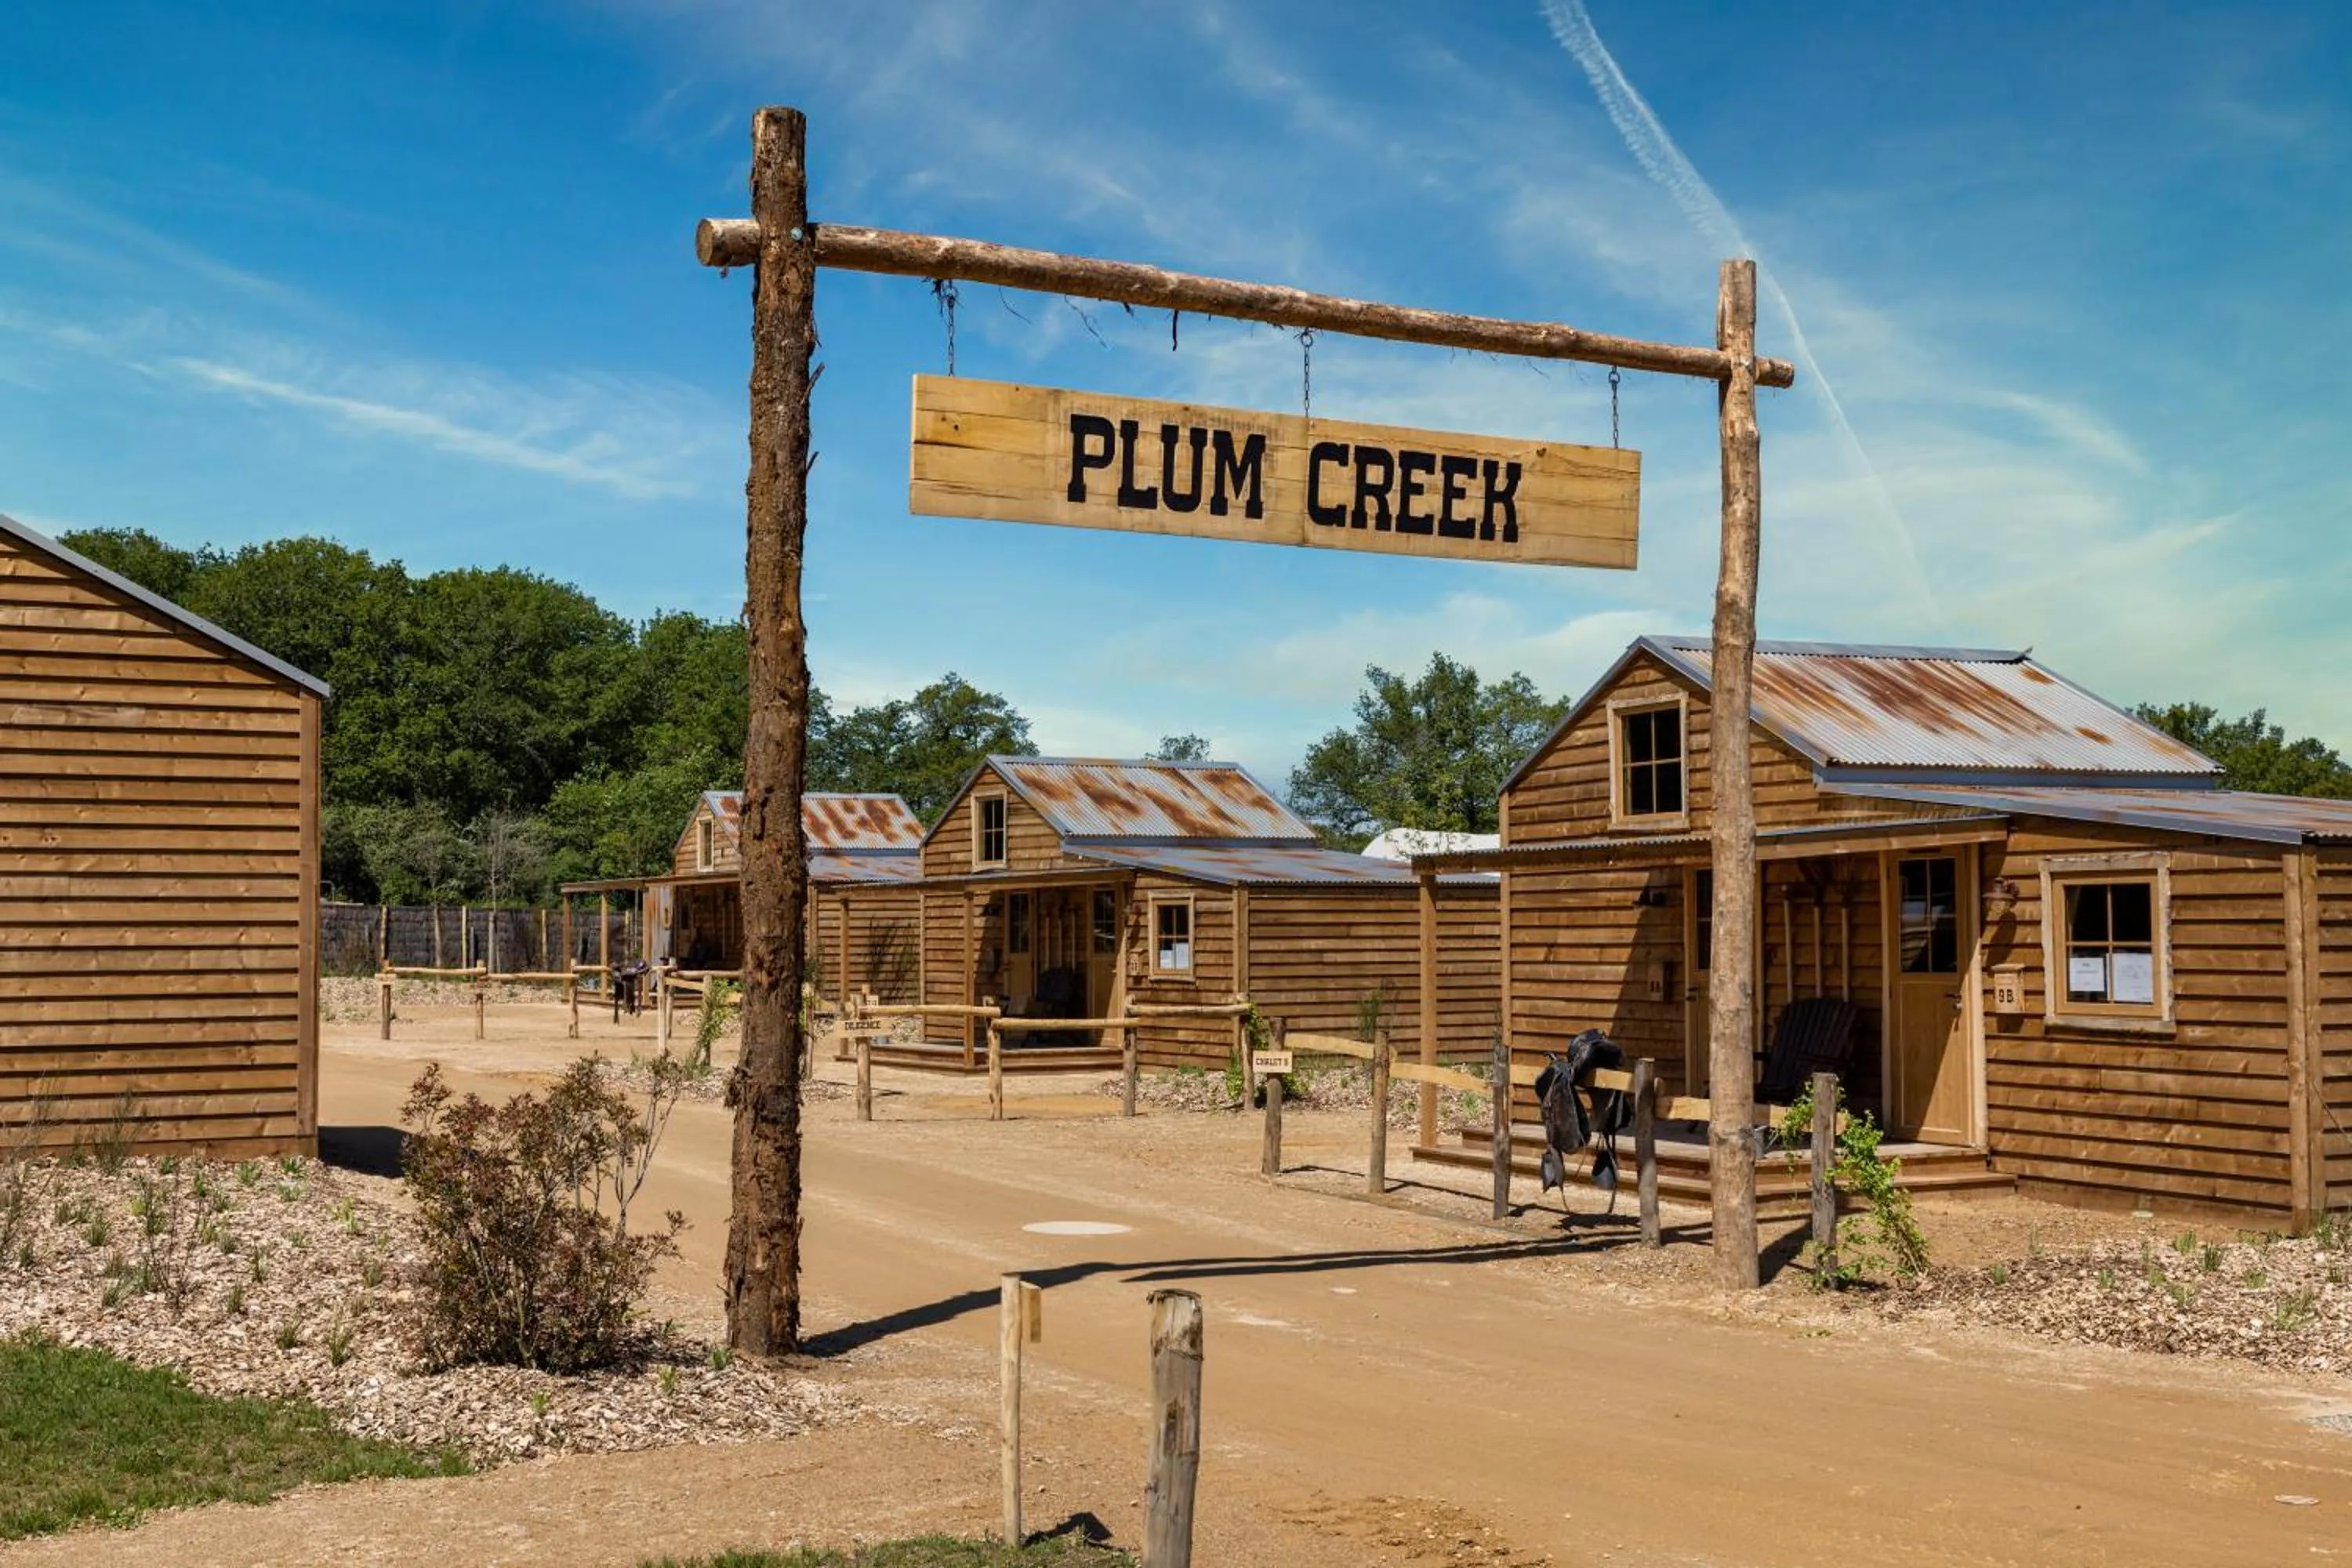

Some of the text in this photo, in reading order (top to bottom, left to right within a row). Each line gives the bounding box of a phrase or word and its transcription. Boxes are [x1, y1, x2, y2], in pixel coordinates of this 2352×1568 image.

[1068, 414, 1521, 543] PLUM CREEK
[1998, 989, 2014, 1003] 9B
